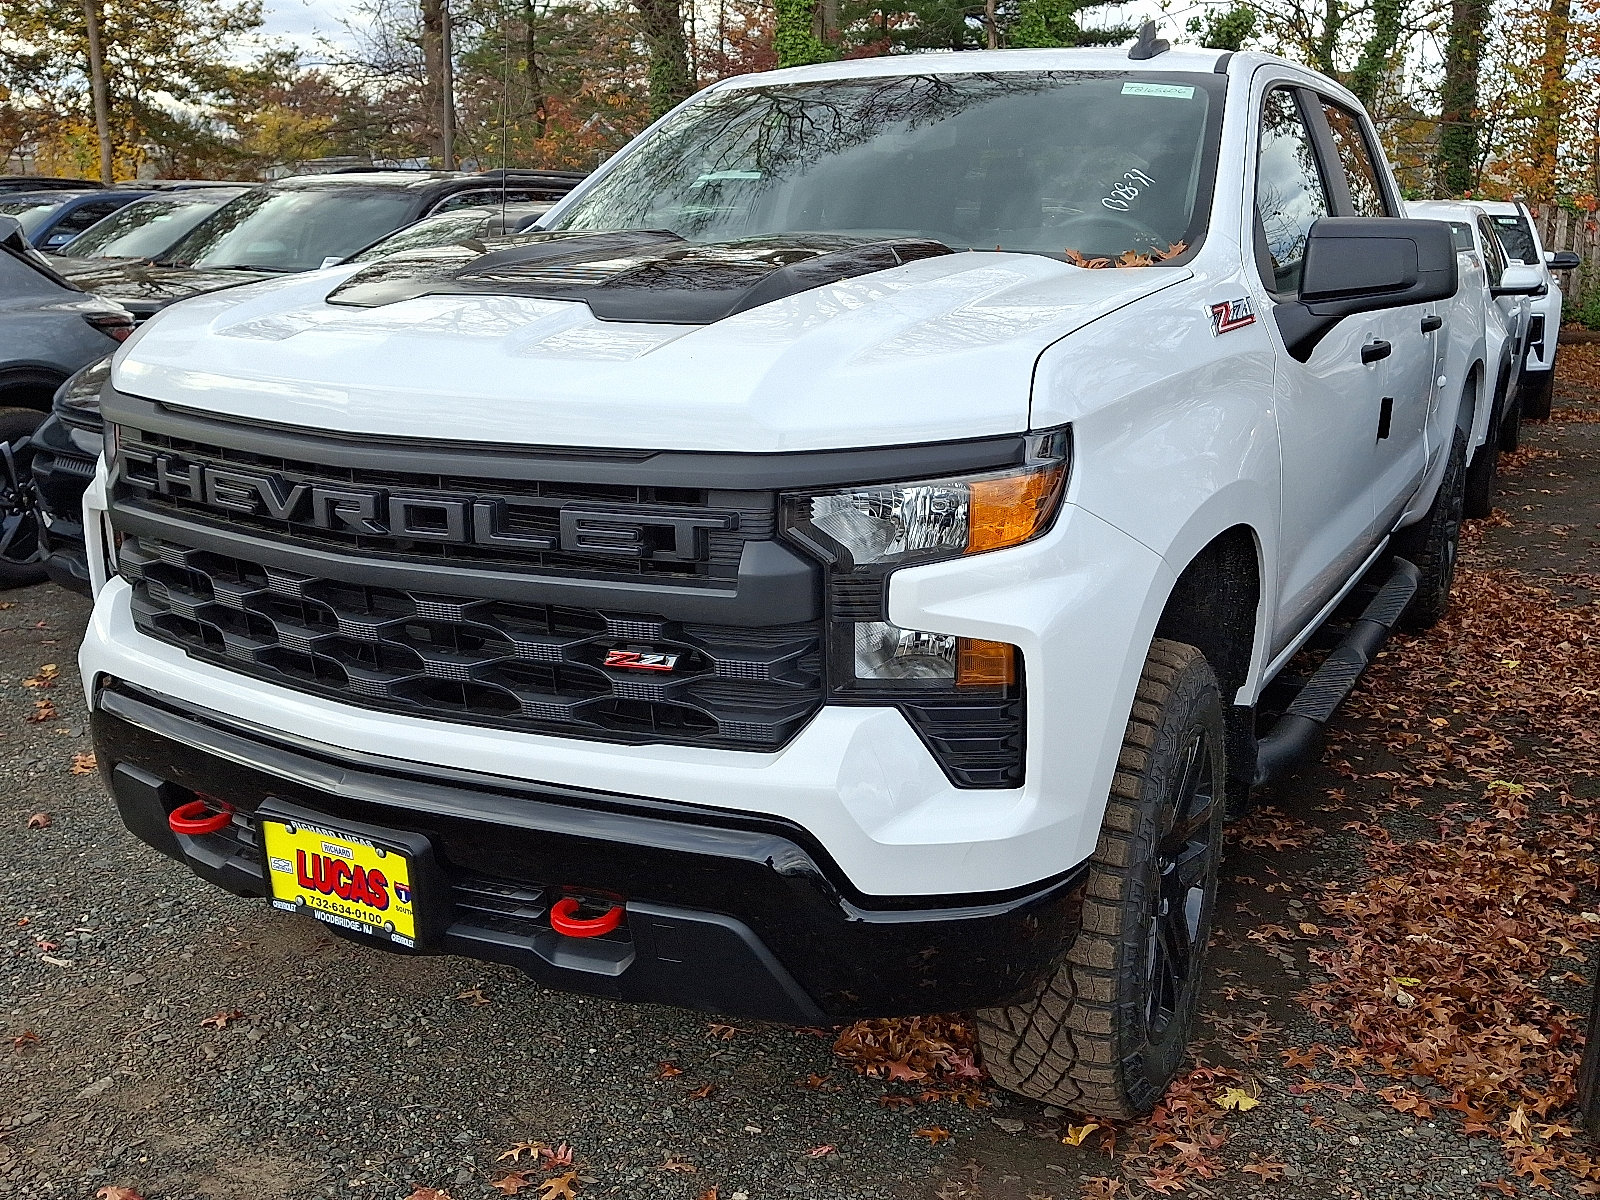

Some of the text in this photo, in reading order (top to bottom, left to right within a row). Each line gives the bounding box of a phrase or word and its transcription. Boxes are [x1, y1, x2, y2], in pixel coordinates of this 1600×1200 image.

[1204, 296, 1256, 337] Z71
[116, 446, 740, 564] CHEVROLET
[603, 650, 679, 671] Z71
[290, 820, 374, 847] RICHARD LUCAS
[323, 843, 351, 857] RICHARD
[296, 849, 389, 911] LUCAS
[400, 889, 407, 902] 1
[309, 895, 382, 924] 732-634-0100
[362, 923, 373, 934] NJ
